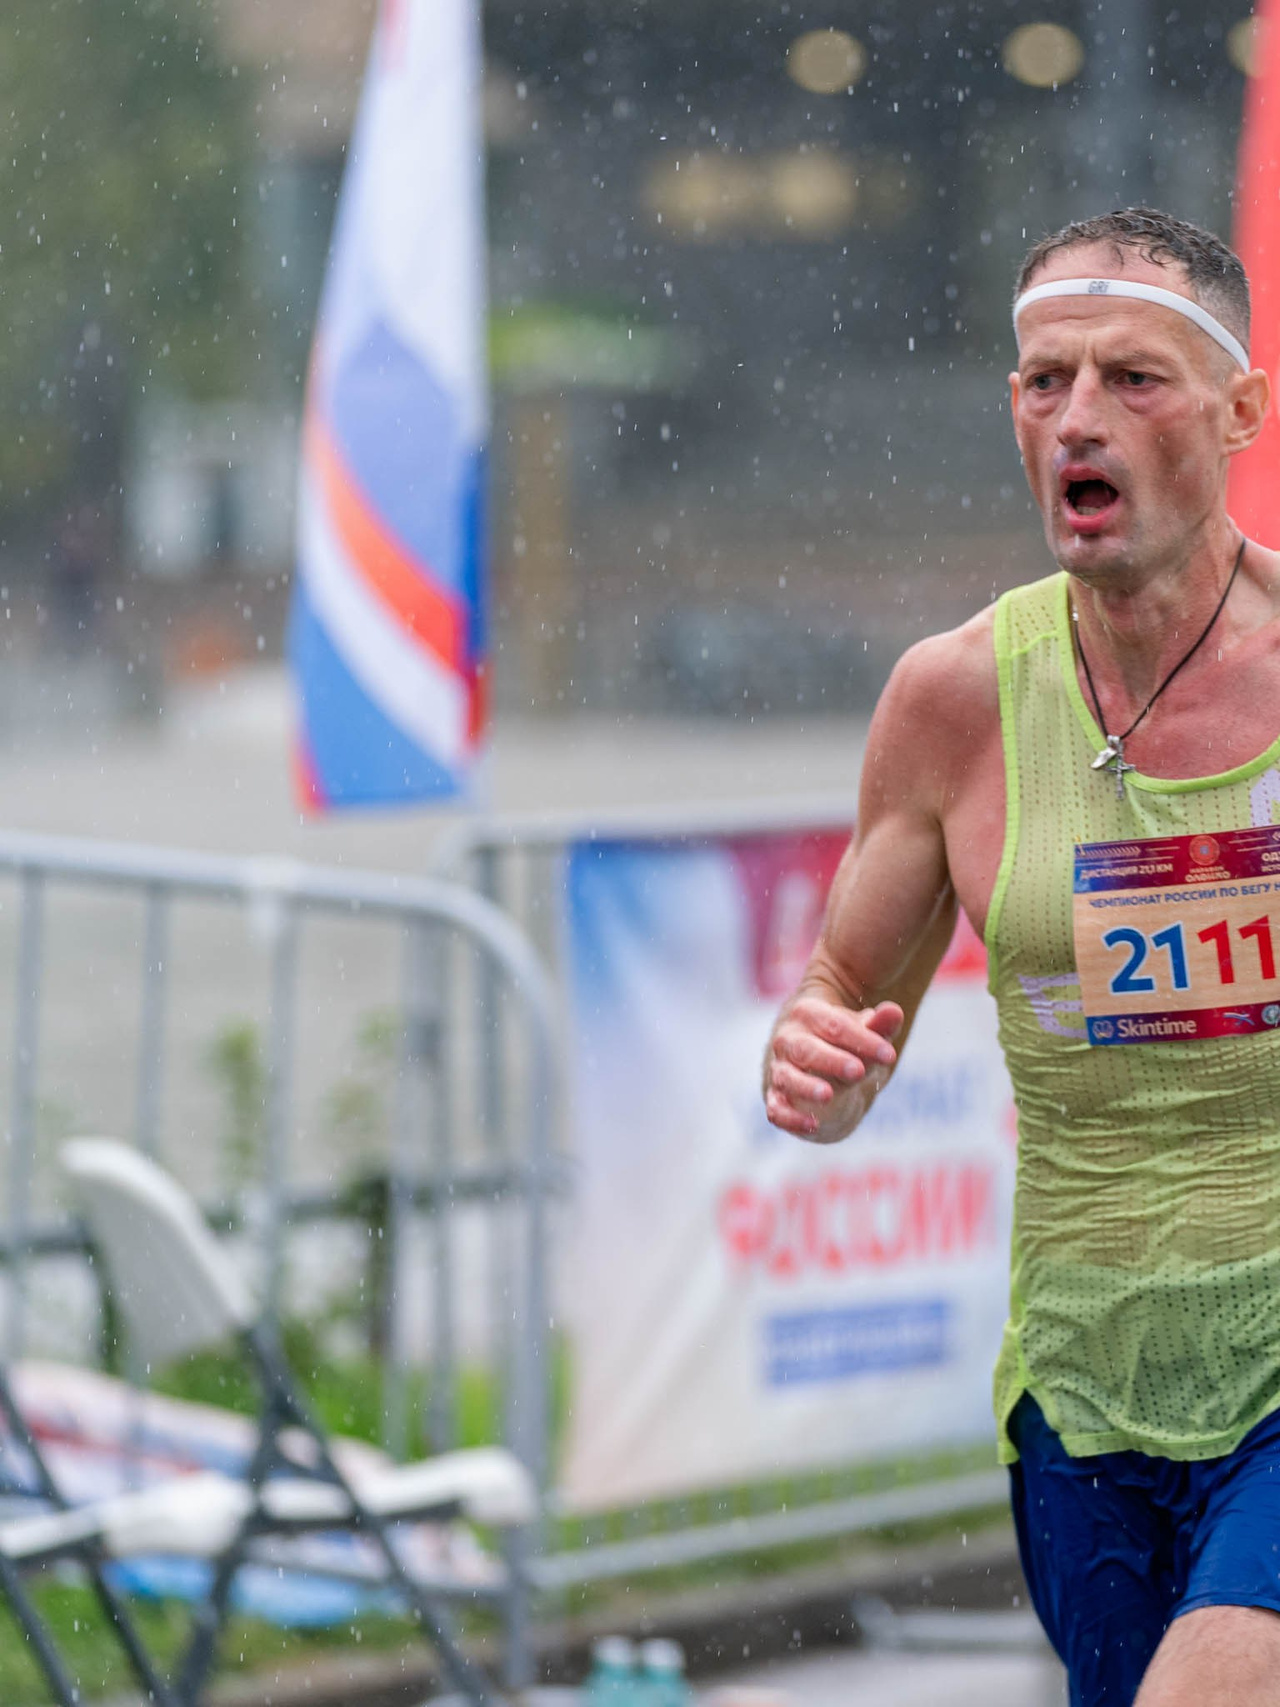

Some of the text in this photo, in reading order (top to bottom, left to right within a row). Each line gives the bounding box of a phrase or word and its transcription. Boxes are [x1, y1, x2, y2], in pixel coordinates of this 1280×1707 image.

[1089, 894, 1161, 908] ЧЕМПИОНАТ
[1165, 888, 1217, 903] РОССИИ
[1219, 886, 1239, 898] ПО
[1241, 883, 1271, 896] БЕГУ
[1117, 1018, 1197, 1037] Skintime
